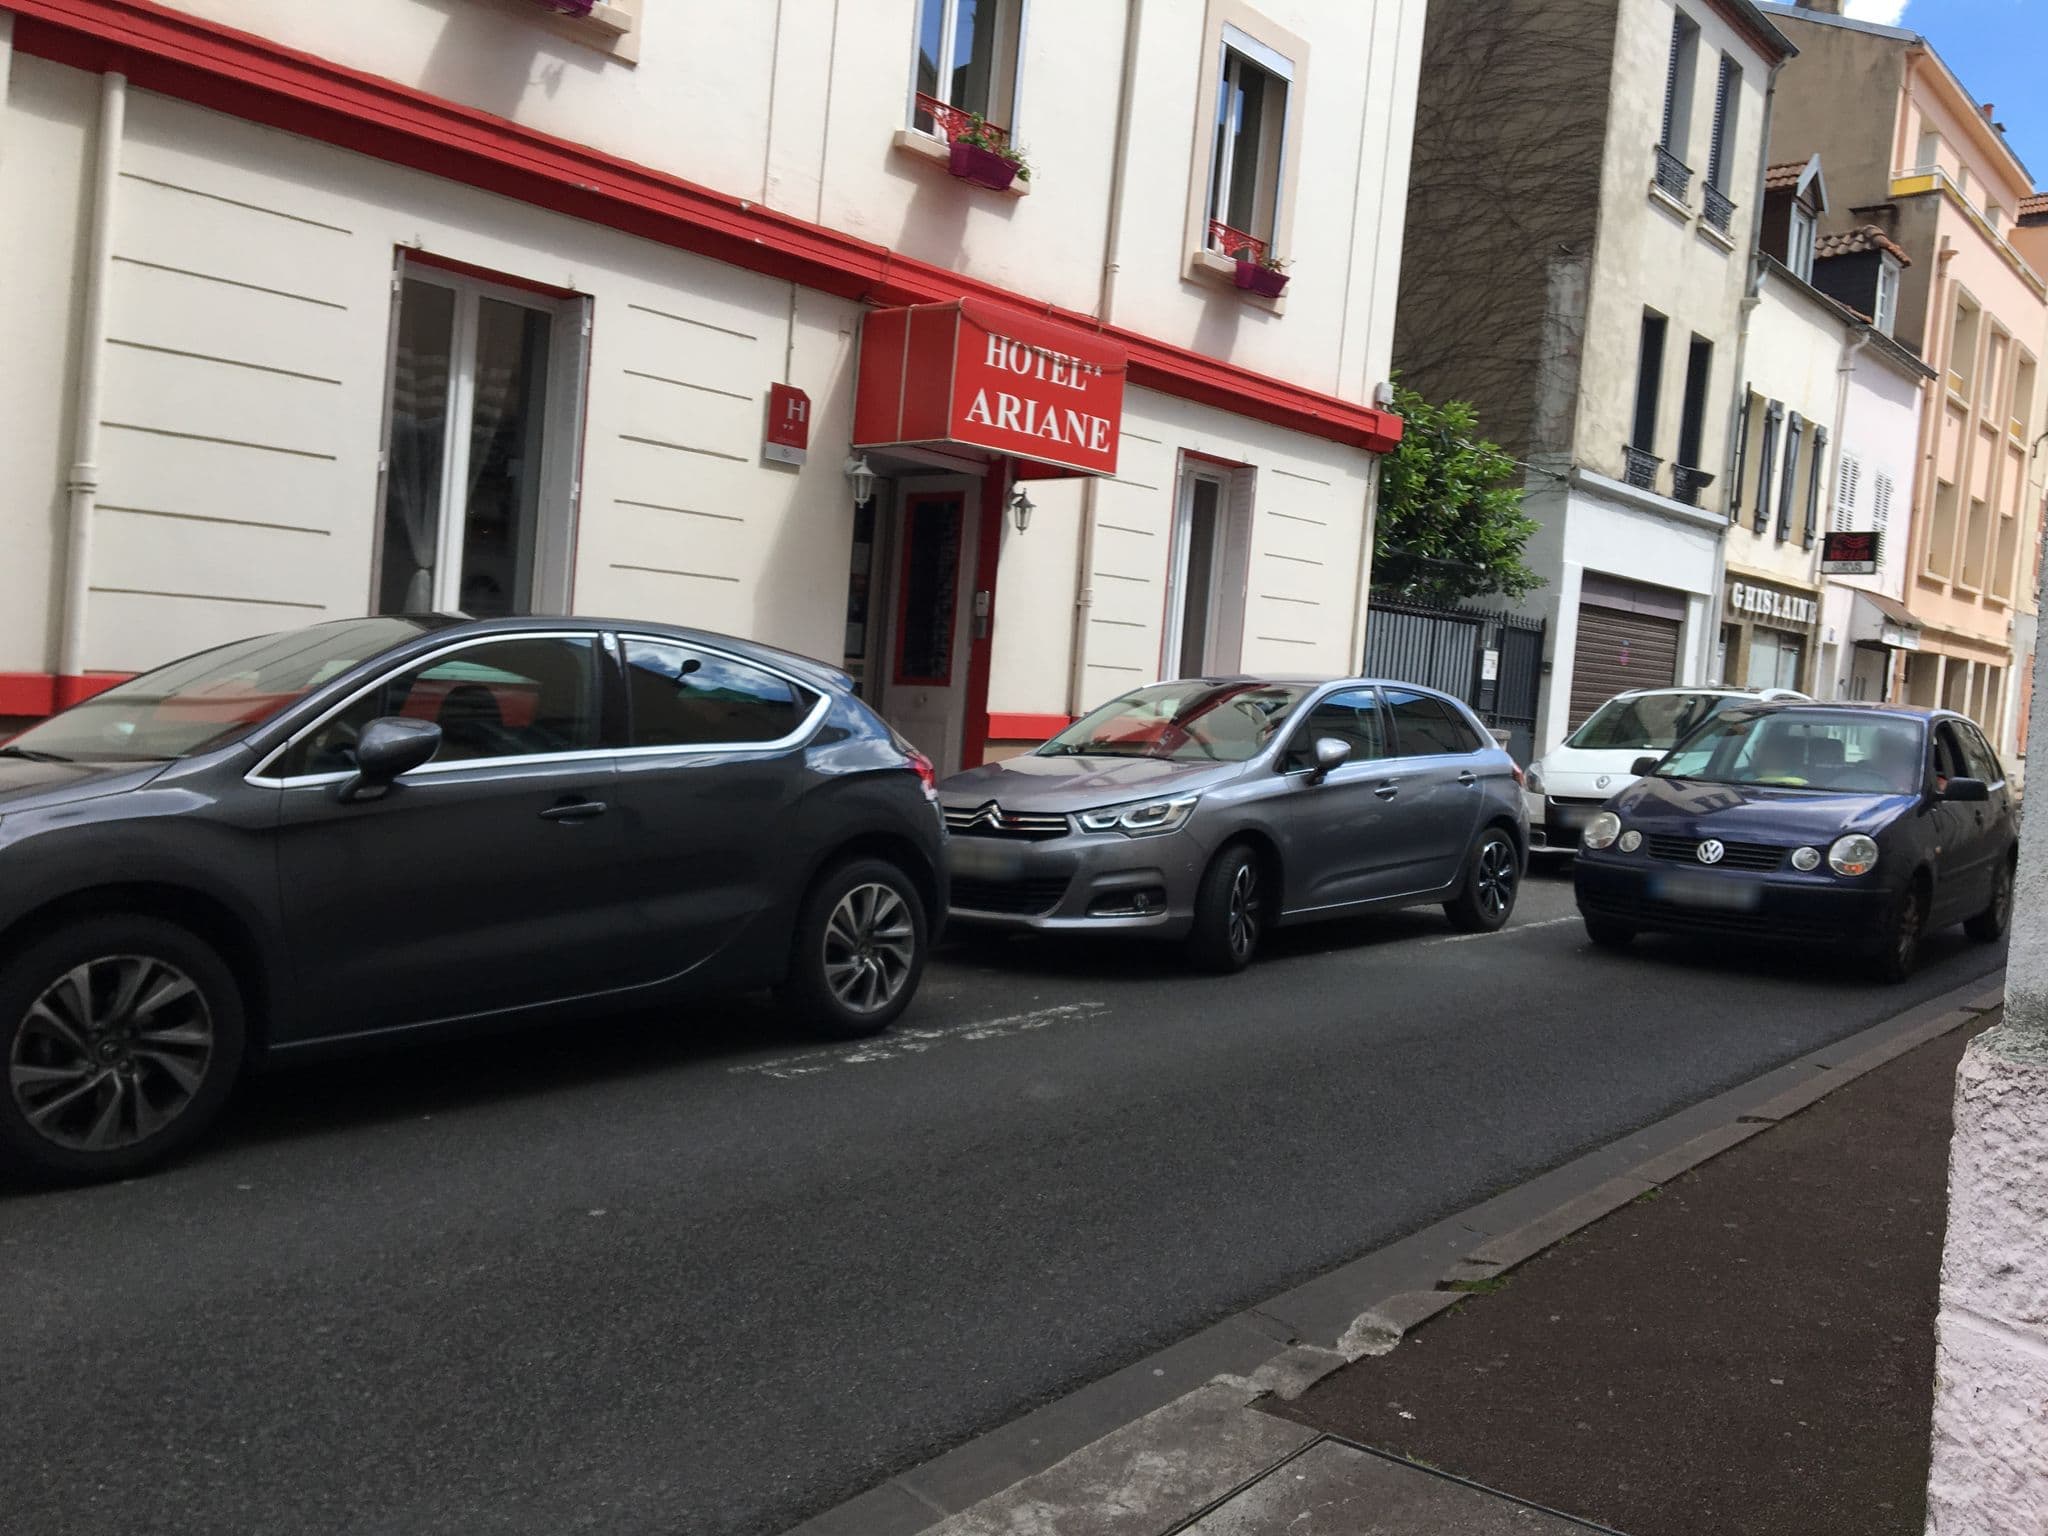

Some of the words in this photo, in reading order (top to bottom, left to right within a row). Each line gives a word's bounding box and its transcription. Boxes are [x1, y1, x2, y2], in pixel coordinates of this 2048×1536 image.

[984, 333, 1087, 391] HOTEL
[787, 398, 805, 422] H
[965, 388, 1111, 453] ARIANE
